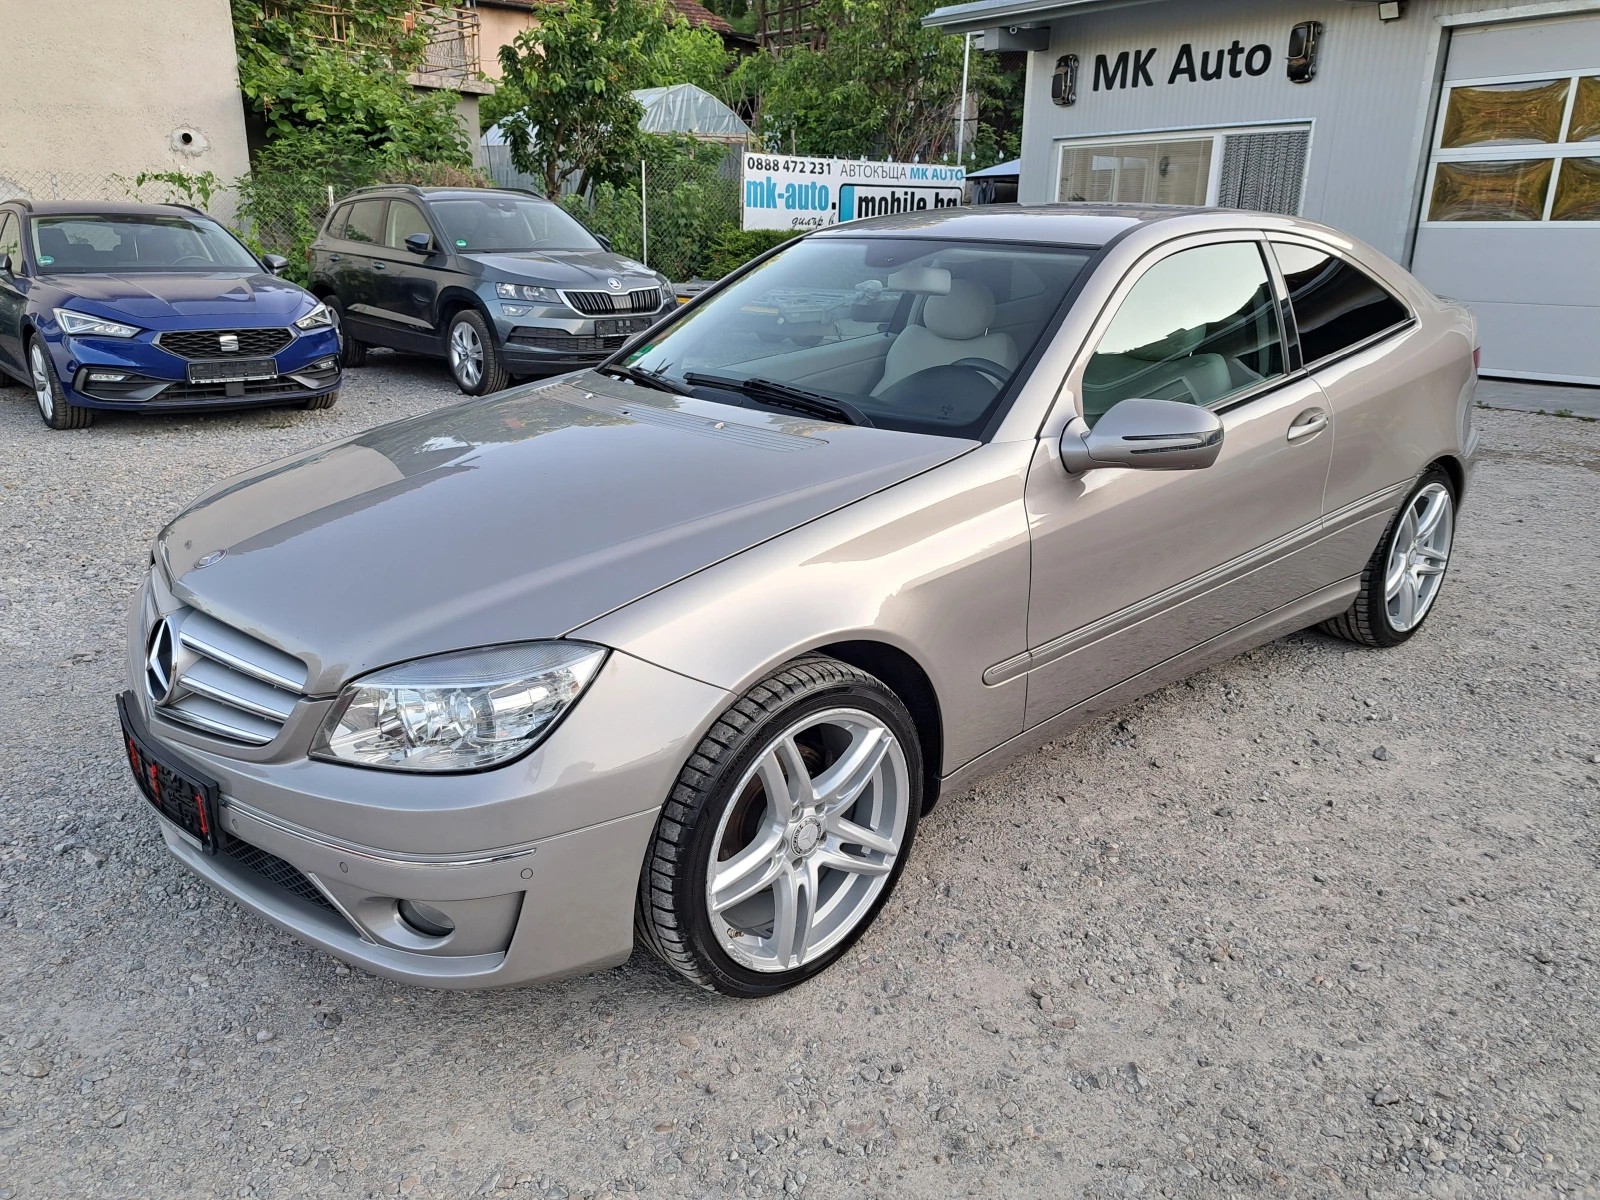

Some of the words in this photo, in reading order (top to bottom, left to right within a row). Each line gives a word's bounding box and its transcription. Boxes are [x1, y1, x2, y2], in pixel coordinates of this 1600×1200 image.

[1092, 48, 1157, 92] MK
[1167, 40, 1272, 85] Auto
[747, 157, 780, 172] 0888
[782, 160, 806, 174] 472
[809, 161, 831, 176] 231
[840, 163, 907, 181] АВТОКЪЩА
[931, 168, 964, 181] AUTO
